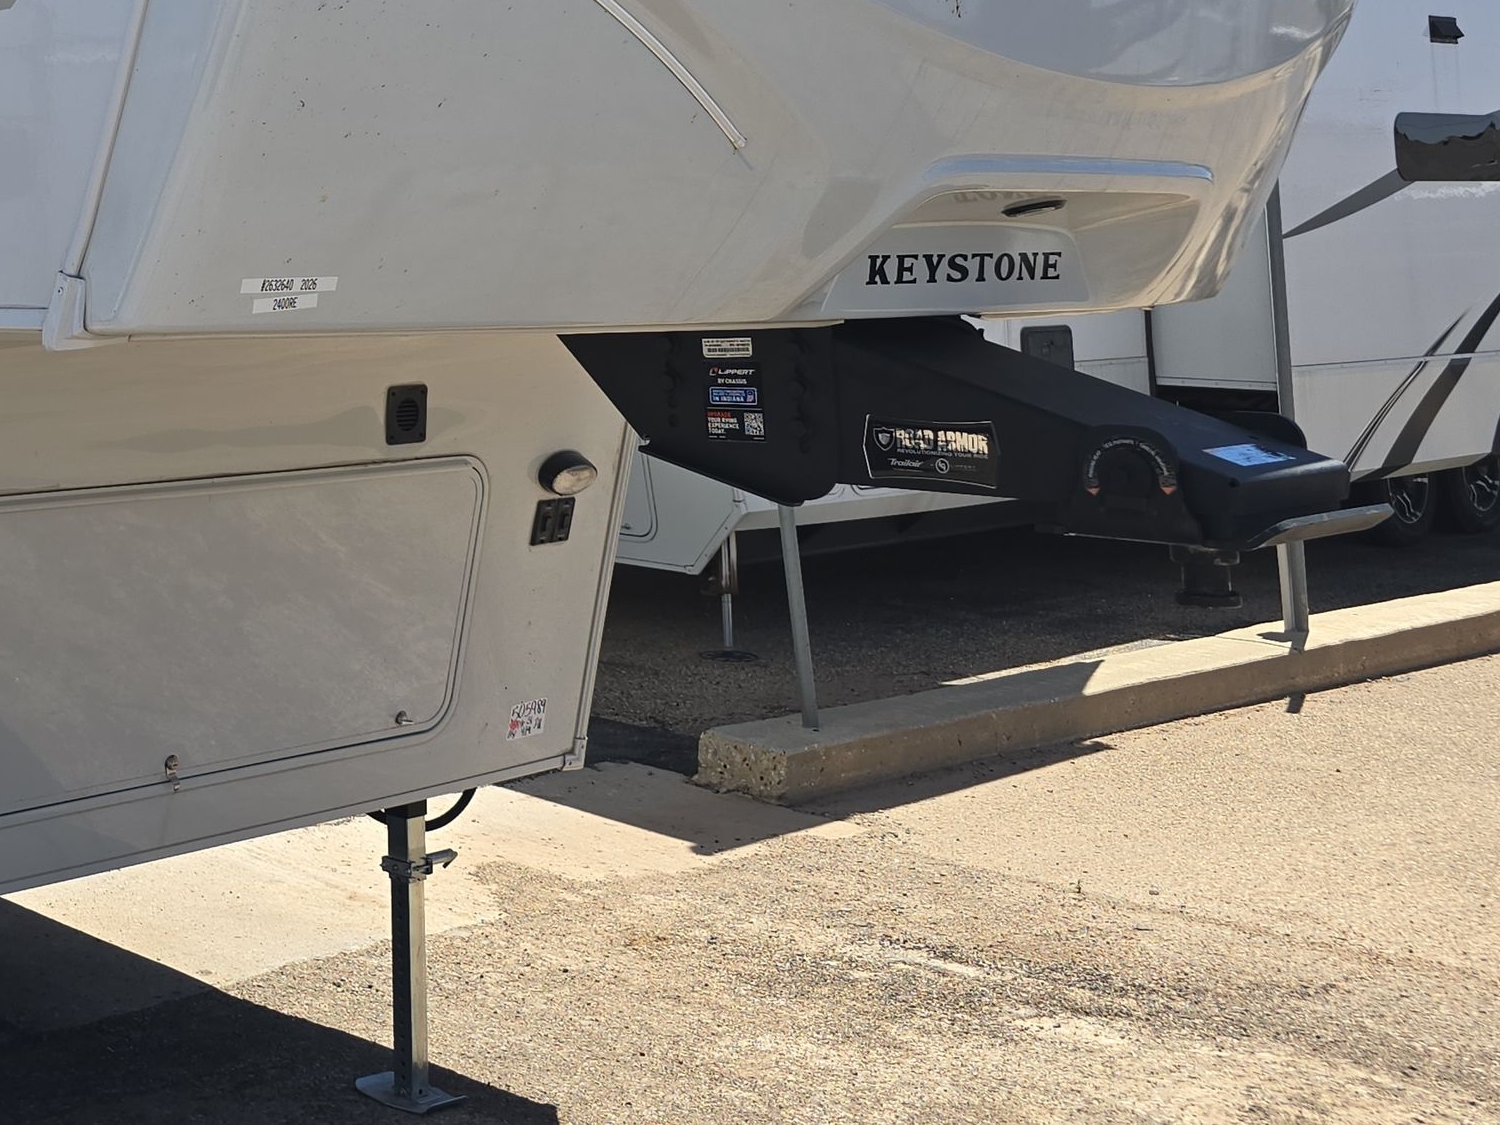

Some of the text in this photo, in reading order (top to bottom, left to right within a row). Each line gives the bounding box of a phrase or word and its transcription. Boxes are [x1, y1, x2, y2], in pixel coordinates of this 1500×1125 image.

[865, 251, 1062, 286] KEYSTONE
[300, 277, 318, 291] 2026
[896, 428, 989, 455] ROAD ARMOR
[888, 457, 924, 468] Trailair
